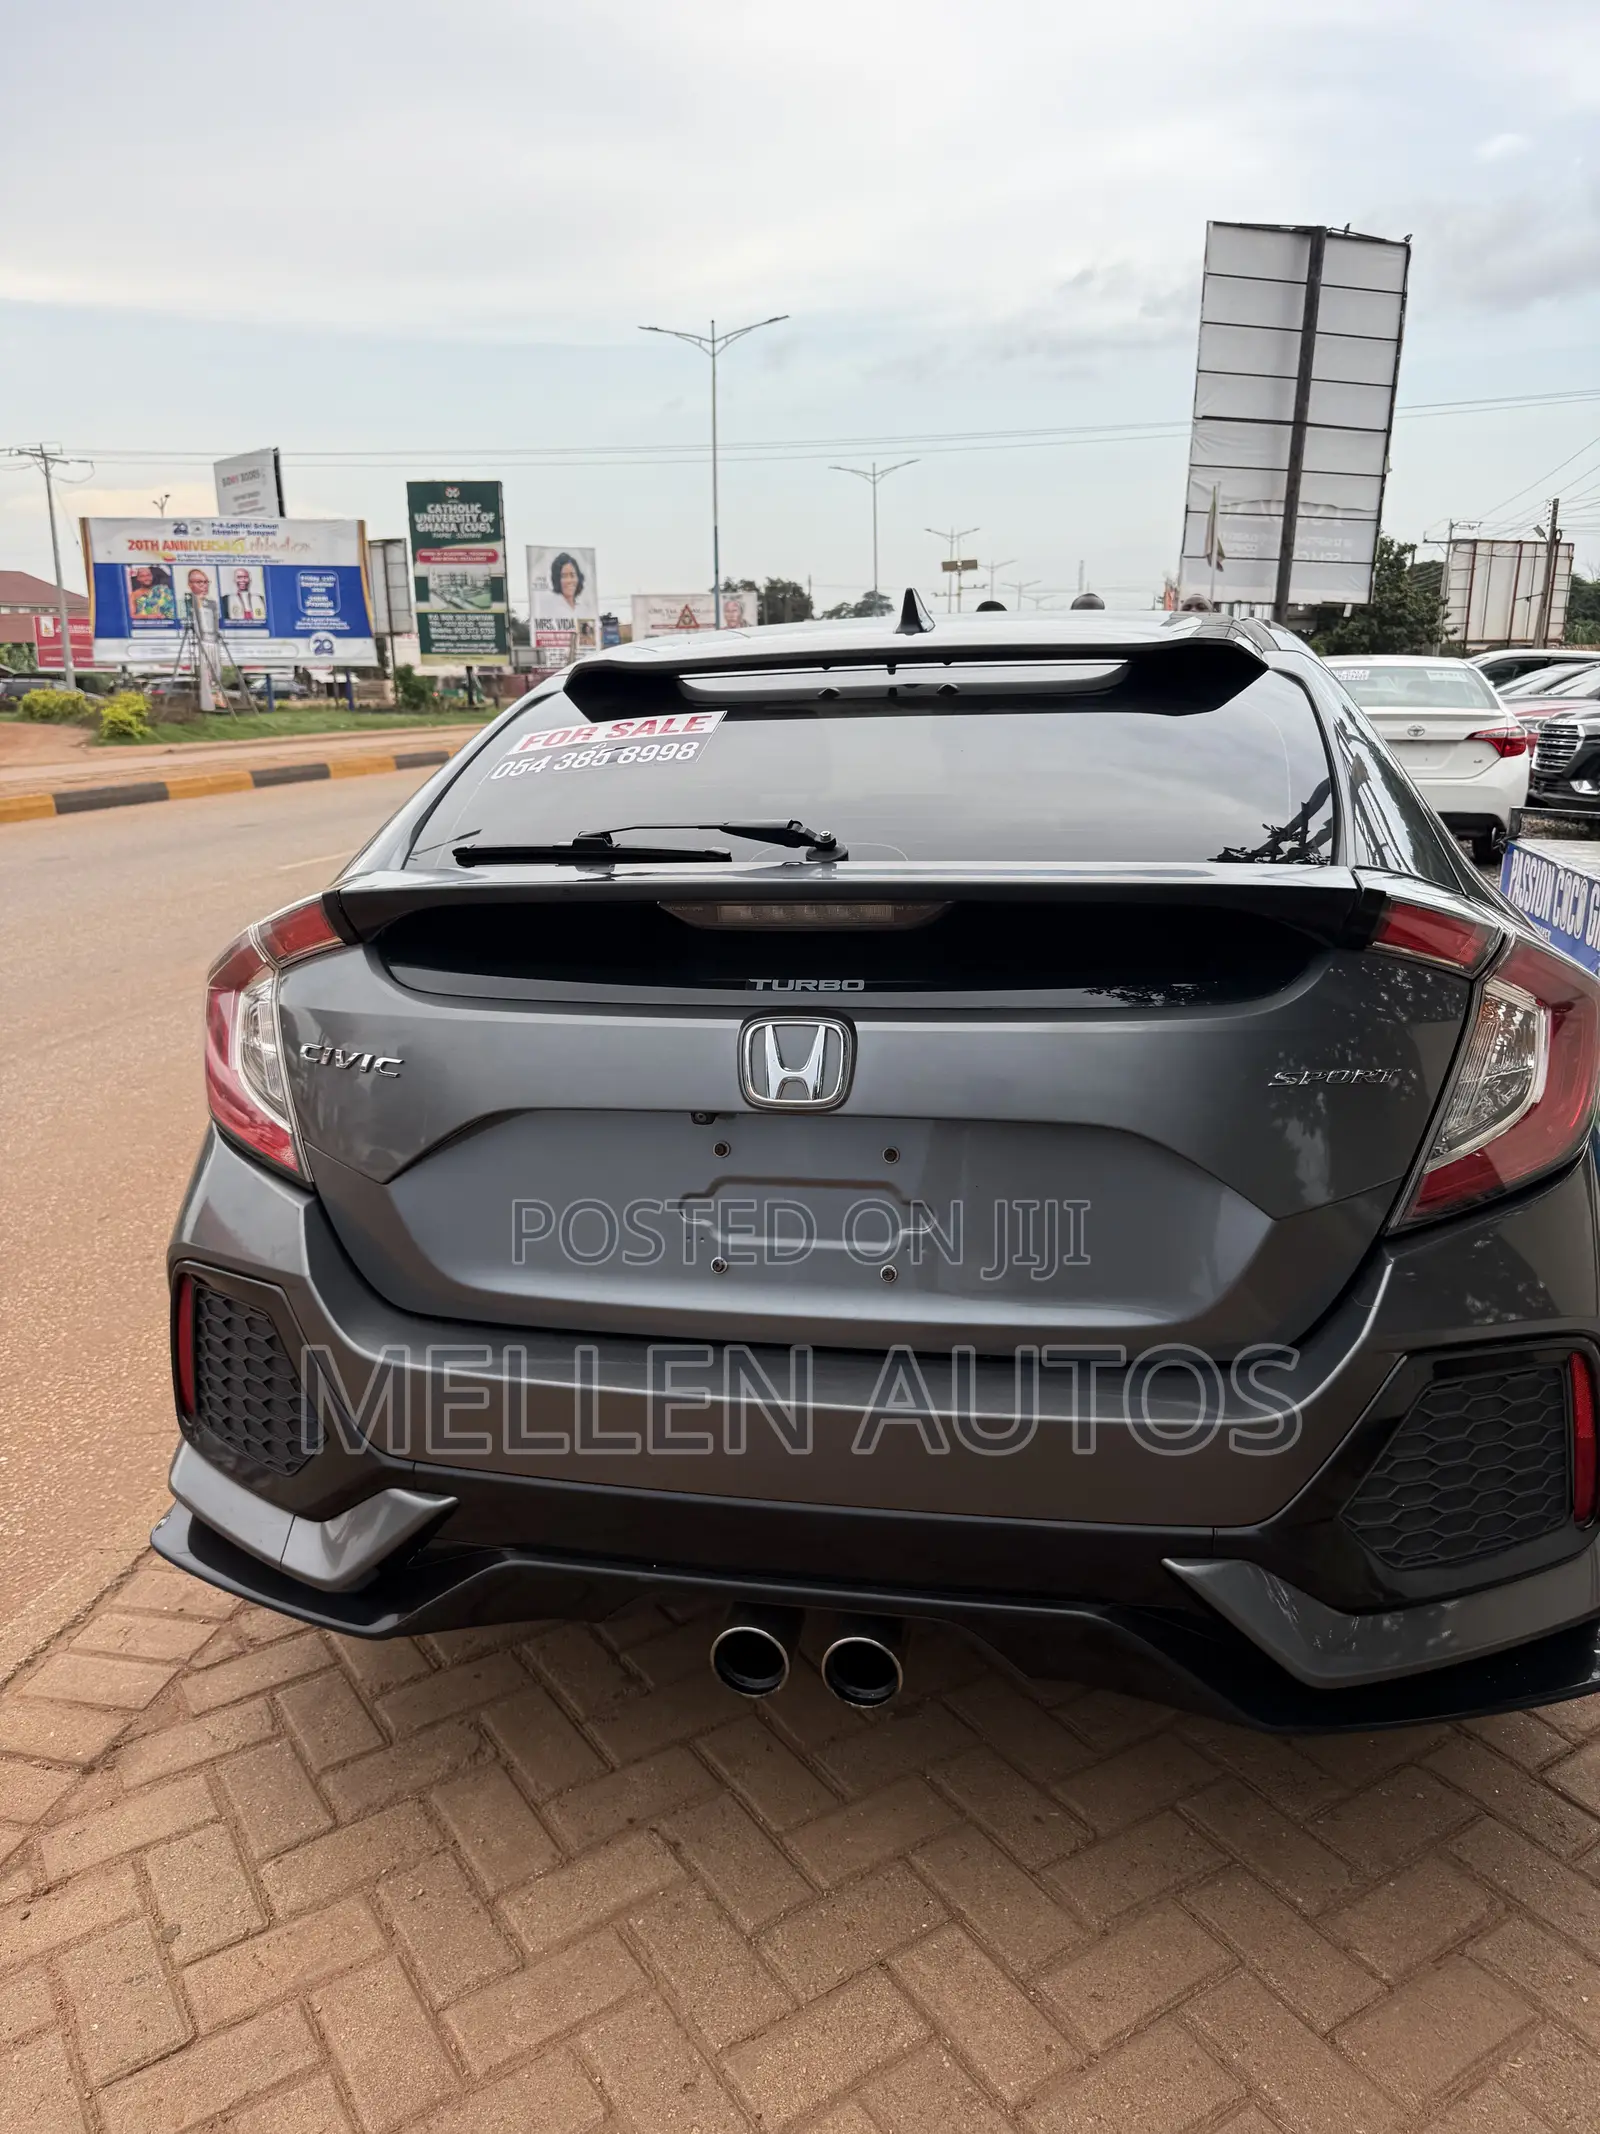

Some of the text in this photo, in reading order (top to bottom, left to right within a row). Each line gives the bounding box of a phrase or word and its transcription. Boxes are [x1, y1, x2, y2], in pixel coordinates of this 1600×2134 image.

[426, 503, 482, 514] CATHOLIC
[414, 513, 496, 523] UNIVERSITY OF
[416, 523, 458, 533] GHANA
[128, 539, 159, 551] 20TH
[519, 715, 713, 751] FOR SALE
[490, 755, 553, 781] 054
[617, 741, 700, 765] 8998
[1508, 848, 1556, 922] PASSION
[748, 978, 865, 992] TURBO
[299, 1042, 405, 1079] CIVIC
[1267, 1067, 1402, 1087] SPORT
